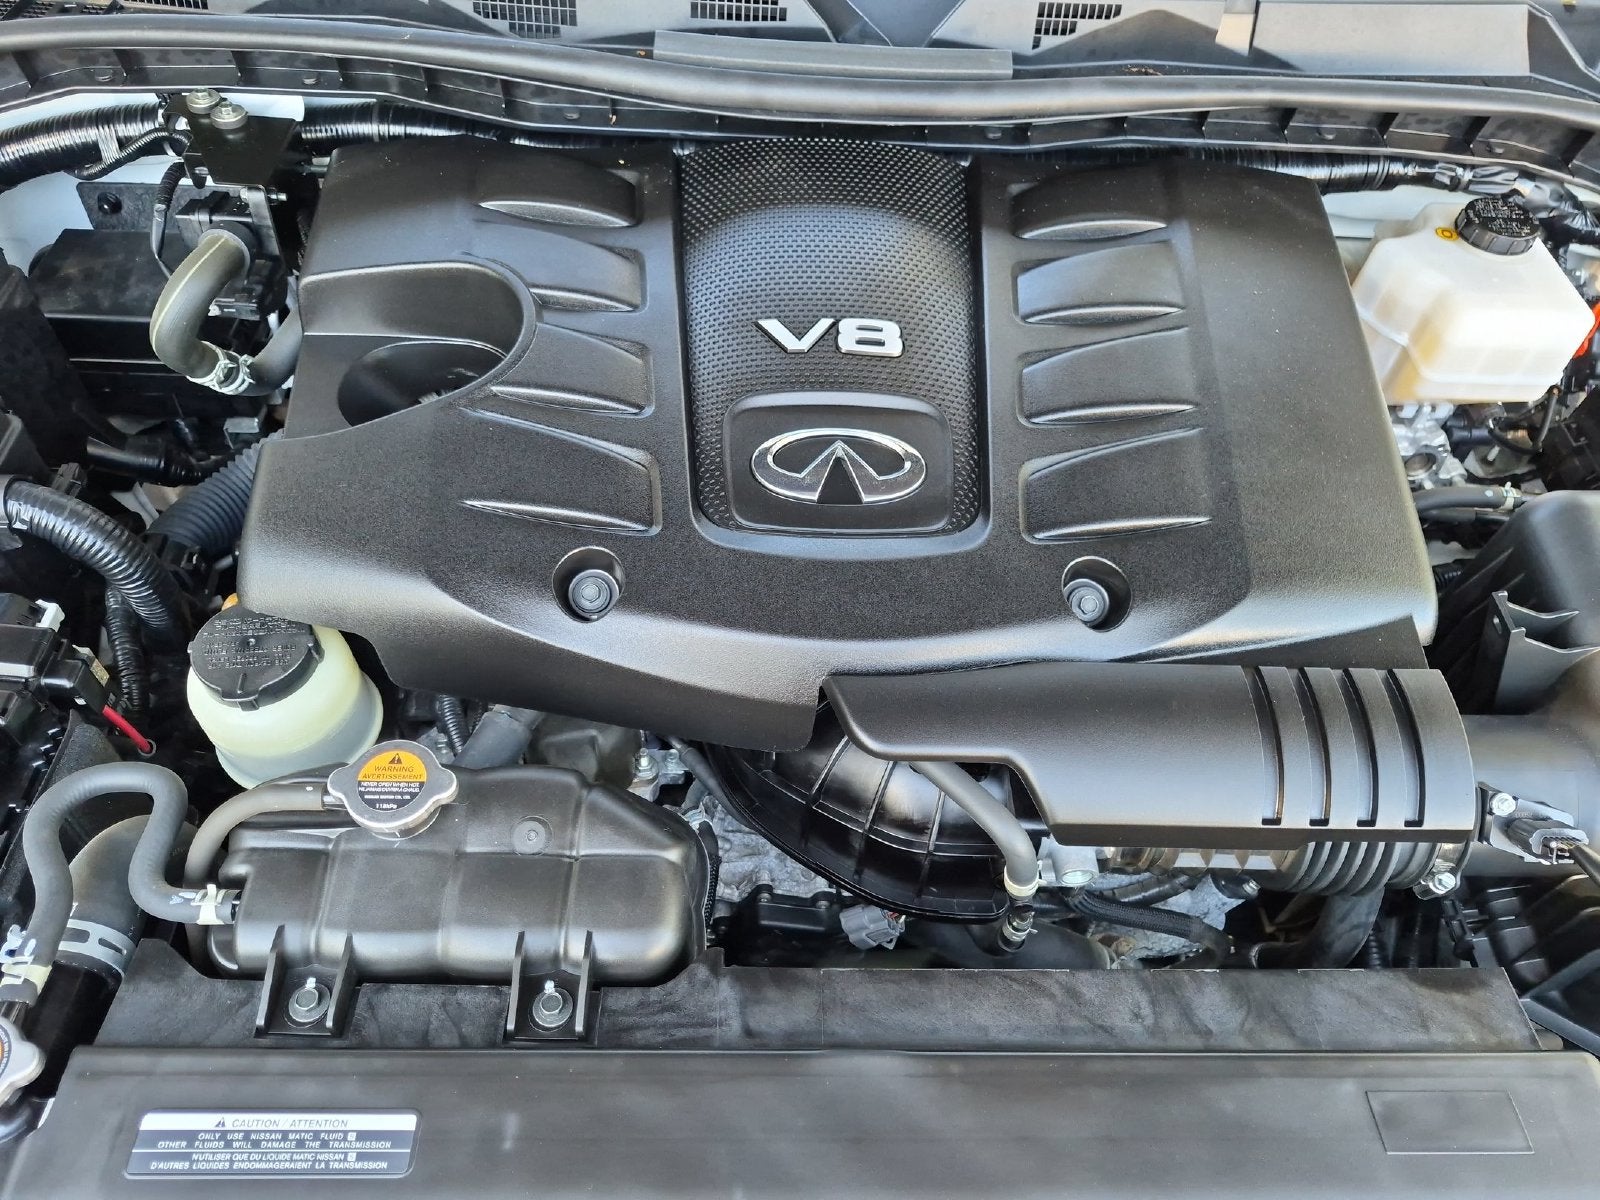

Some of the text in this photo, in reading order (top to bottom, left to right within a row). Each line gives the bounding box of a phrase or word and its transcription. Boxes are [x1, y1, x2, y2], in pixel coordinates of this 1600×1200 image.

[753, 317, 904, 357] V8
[374, 765, 415, 773] WARNING
[231, 1118, 281, 1129] CAUTION
[289, 1118, 349, 1129] ATTENTION
[197, 1132, 221, 1140] ONLY
[226, 1132, 245, 1140] USE
[250, 1132, 282, 1140] NISSAN
[287, 1132, 314, 1140] MATIC
[319, 1132, 344, 1140] FLUID
[157, 1141, 392, 1149] OTHER FLUIDS WILL DAMAGE THE TRANSMISSION
[191, 1153, 230, 1161] N'UTILISER
[231, 1153, 249, 1161] QUE
[249, 1153, 262, 1161] DU
[262, 1153, 291, 1161] LIQUIDE
[292, 1153, 315, 1161] MATIC
[316, 1153, 345, 1161] NISSAN
[149, 1161, 388, 1170] D'AUTRES LIQUIDES ENDOMMAGERAIENT LA TRANSMISSION
